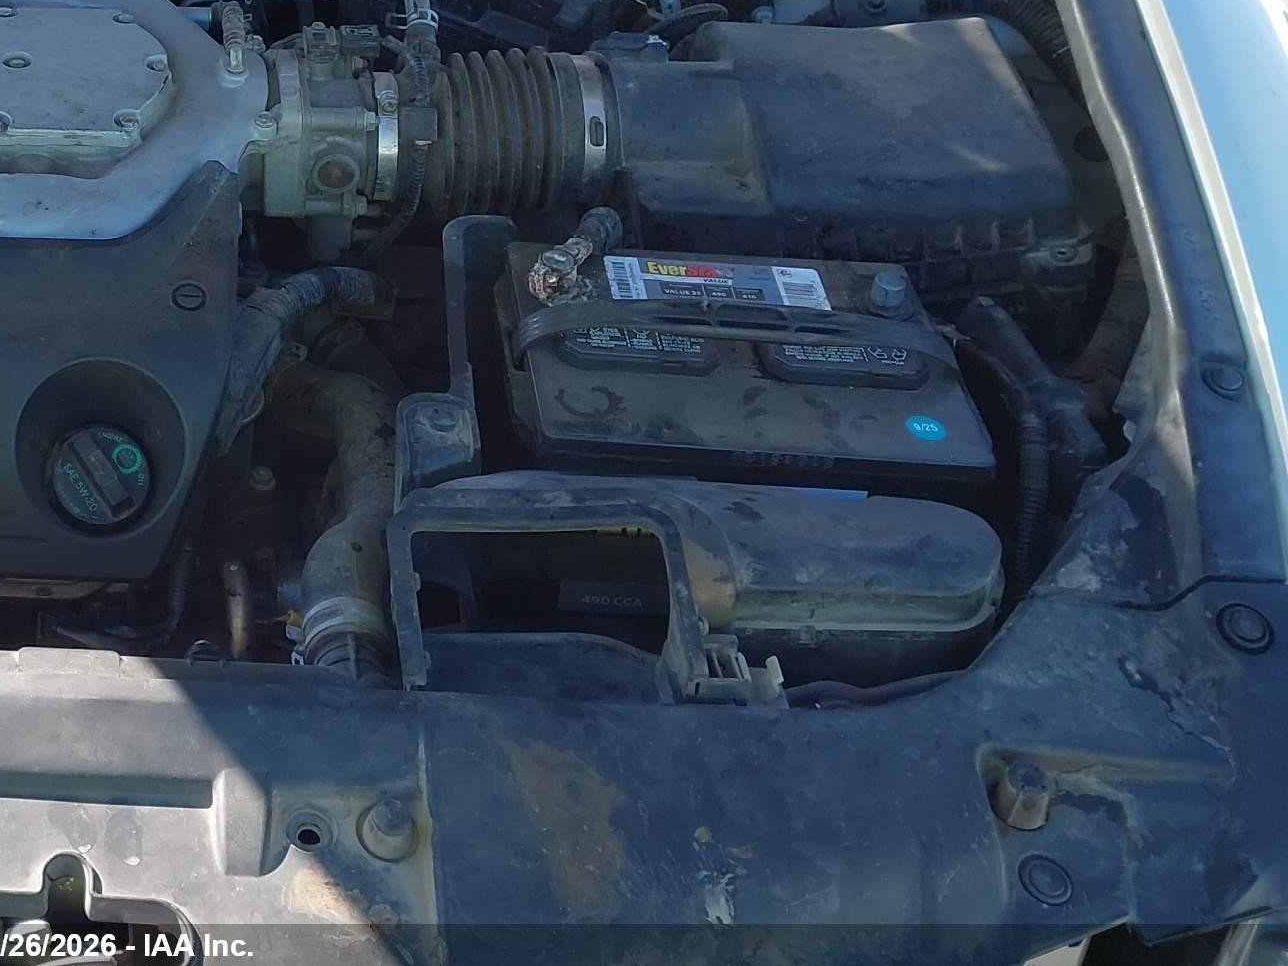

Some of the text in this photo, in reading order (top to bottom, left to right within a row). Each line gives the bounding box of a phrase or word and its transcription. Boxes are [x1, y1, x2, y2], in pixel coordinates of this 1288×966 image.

[663, 287, 691, 297] VALUE
[913, 422, 938, 432] 9/25
[63, 462, 80, 482] SAE
